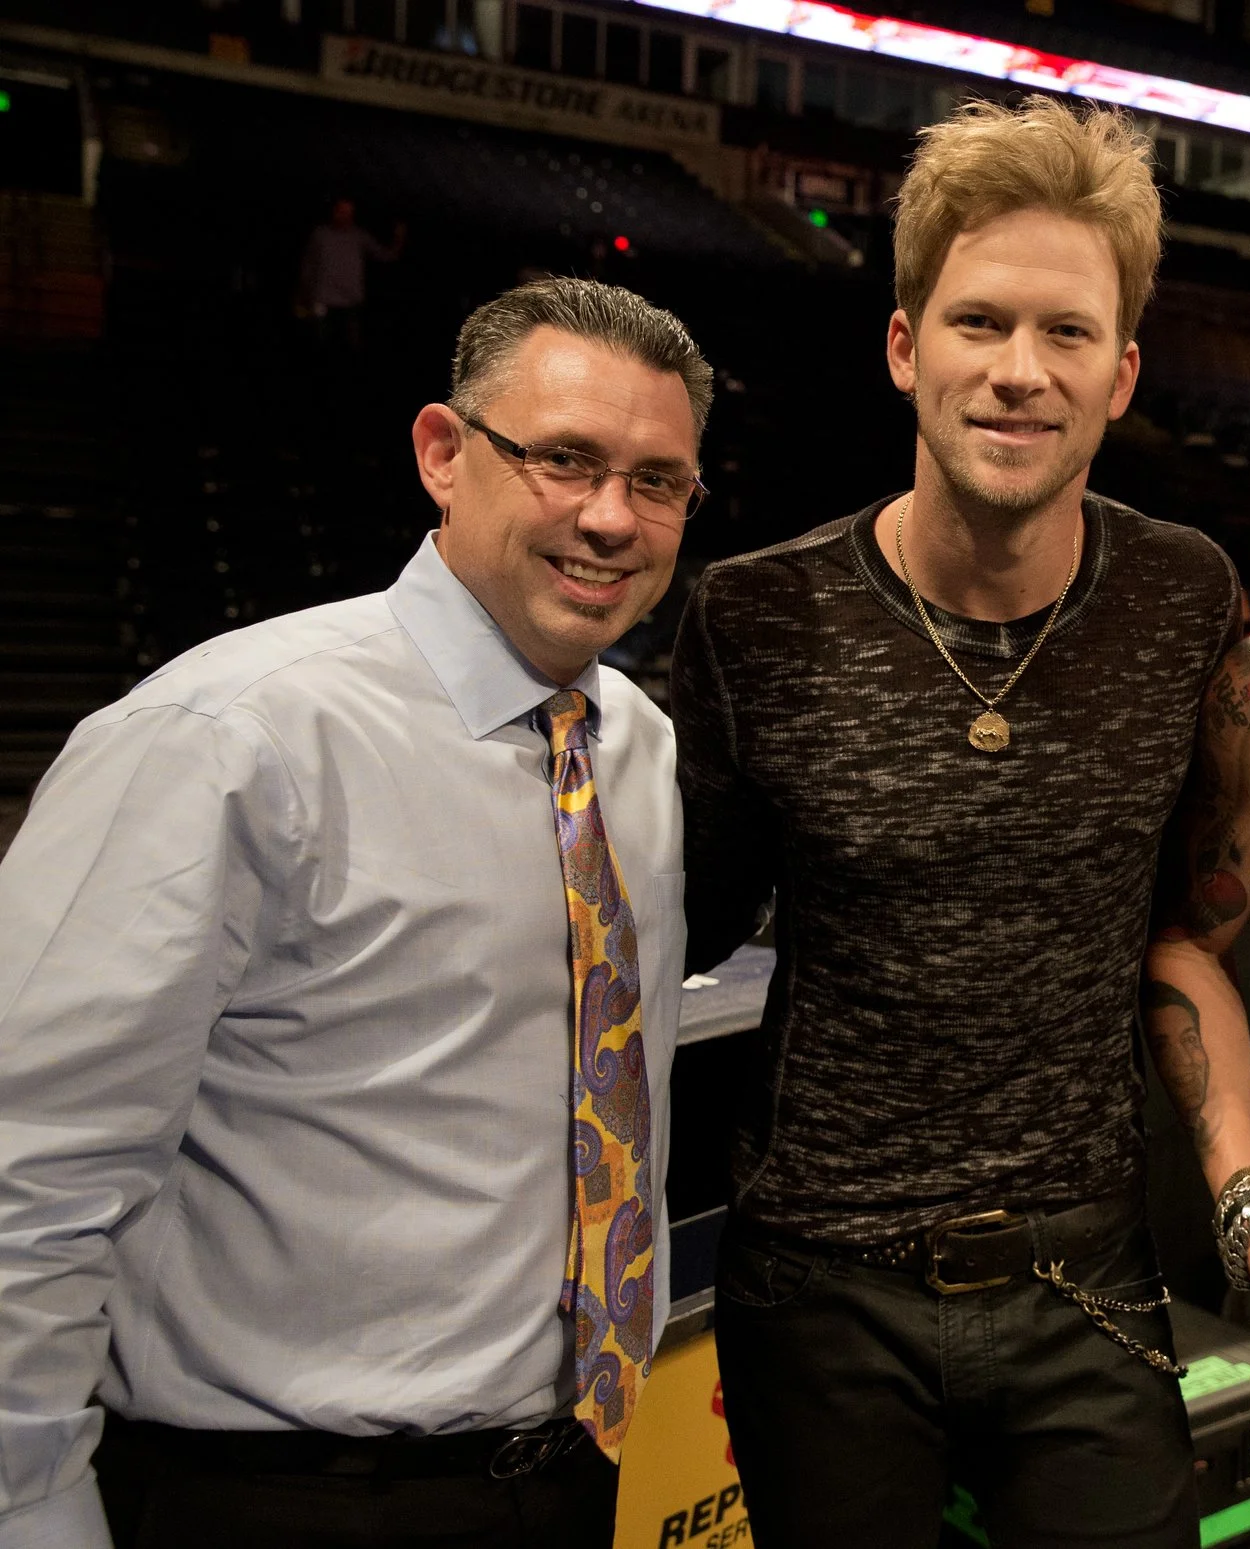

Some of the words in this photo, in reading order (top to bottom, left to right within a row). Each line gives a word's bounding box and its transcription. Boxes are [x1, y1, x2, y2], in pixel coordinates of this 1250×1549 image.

[344, 40, 603, 117] BRIDGESTONE
[616, 100, 708, 133] ARENA
[658, 1484, 746, 1549] REP
